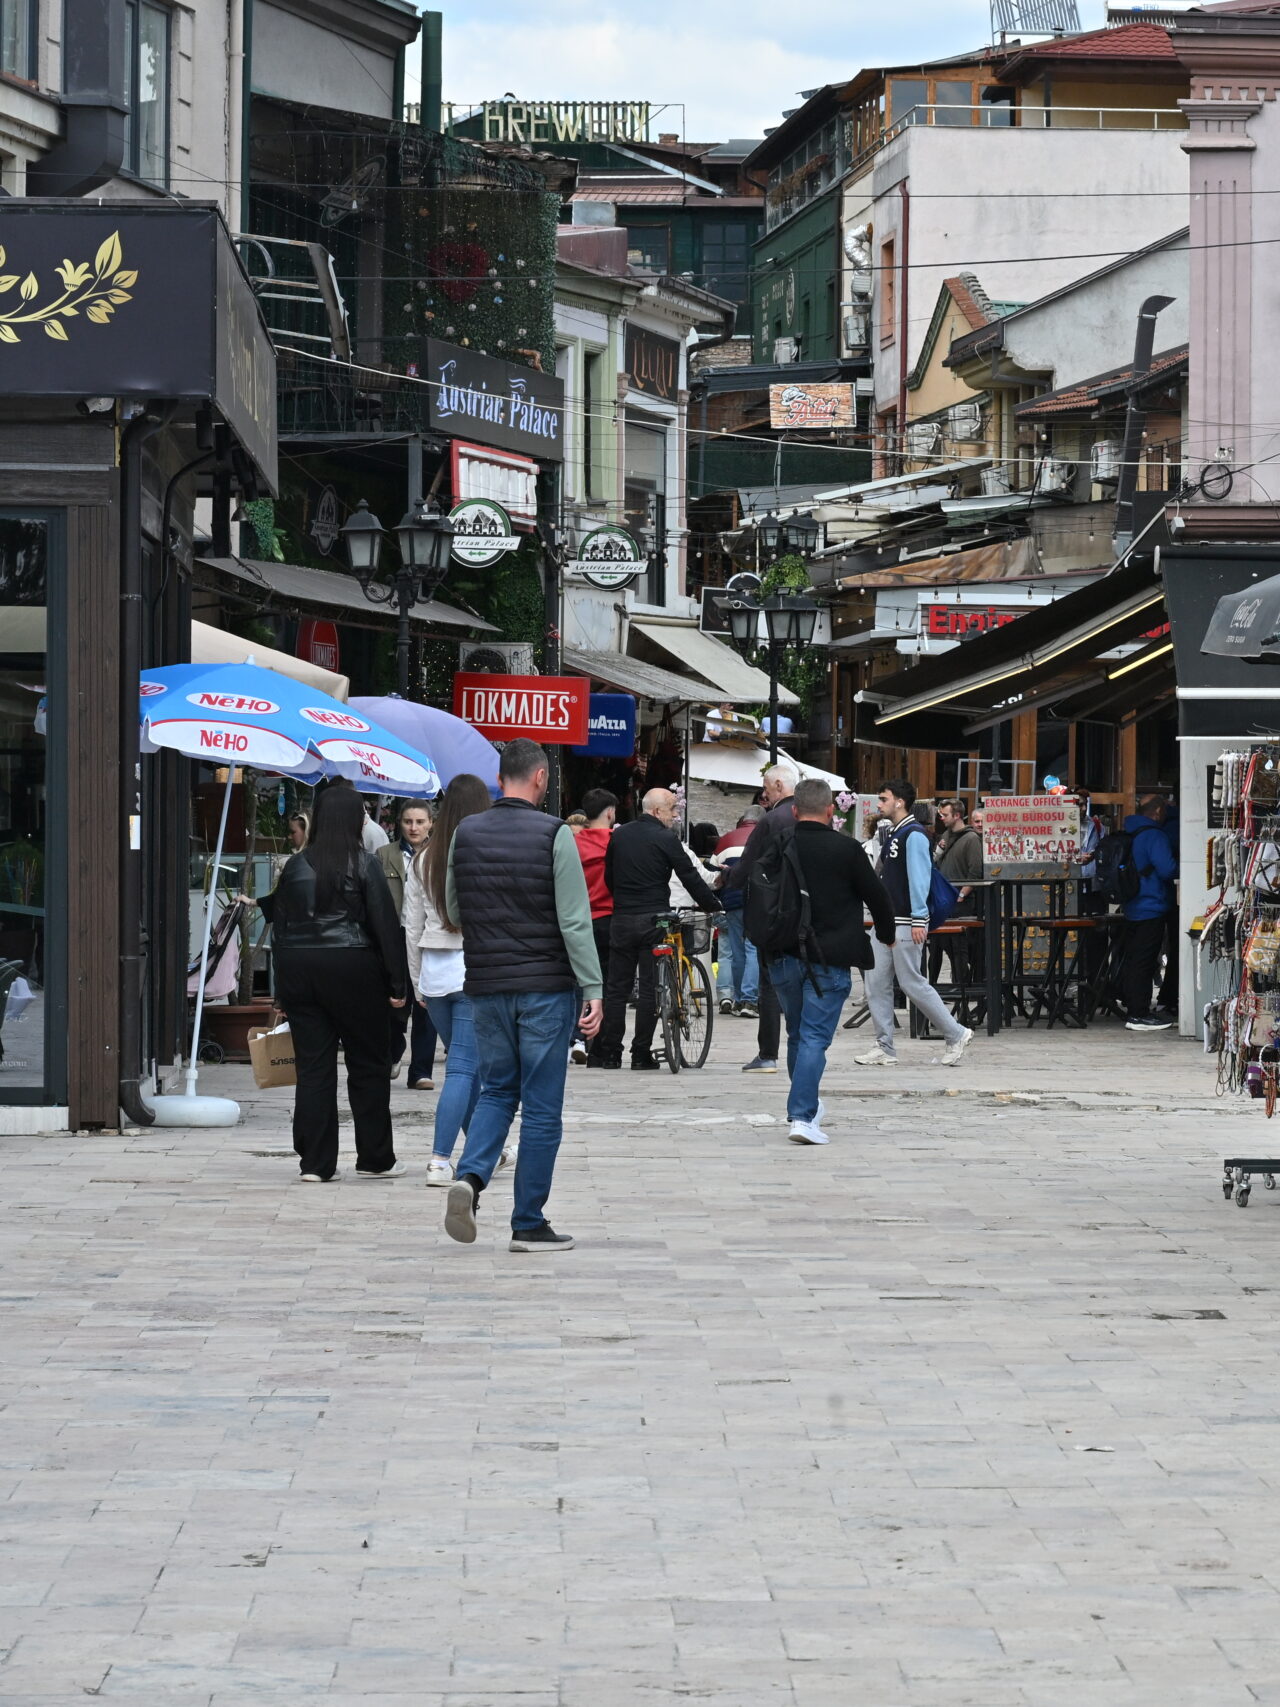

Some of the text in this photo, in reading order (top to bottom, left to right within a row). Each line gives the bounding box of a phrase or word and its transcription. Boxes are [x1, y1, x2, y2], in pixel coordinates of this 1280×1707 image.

[436, 360, 558, 440] Austrian Palace
[588, 715, 627, 730] VAZZA
[985, 797, 1062, 808] EXCHANGE OFFICE
[270, 1056, 295, 1066] sinsa
